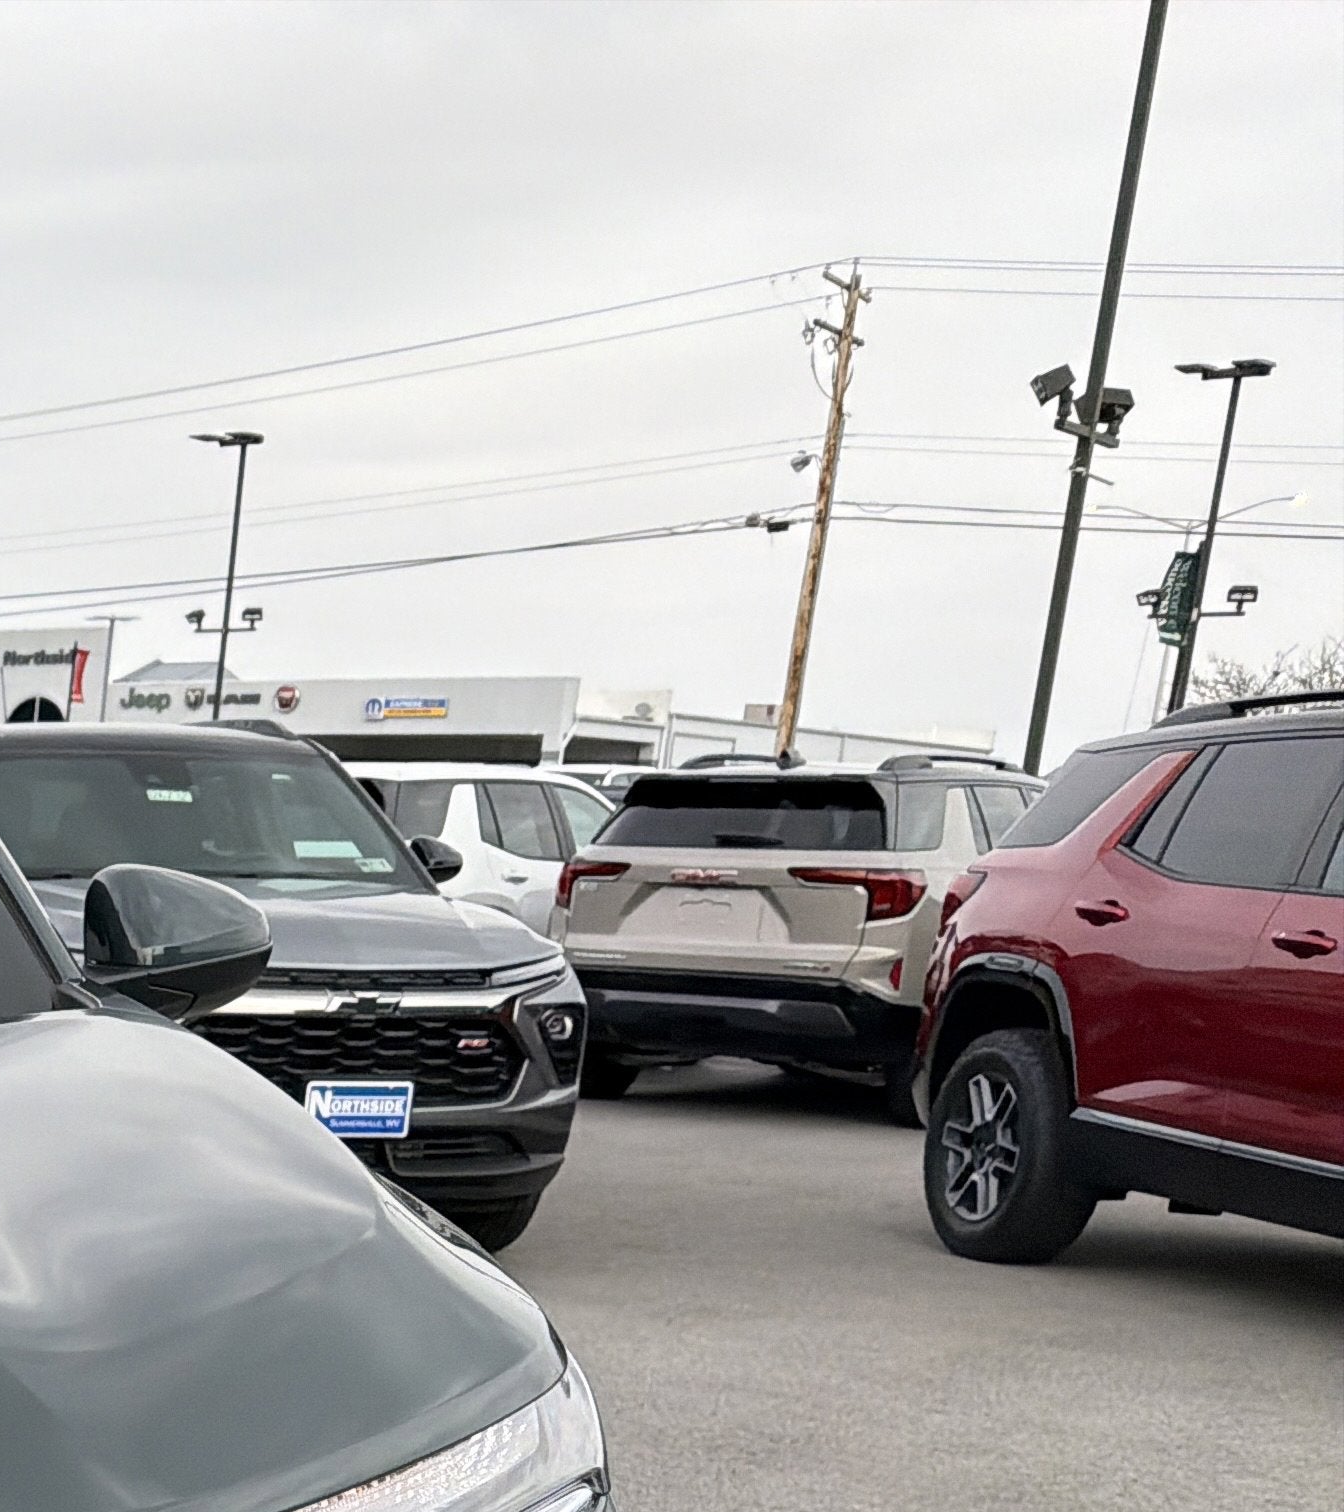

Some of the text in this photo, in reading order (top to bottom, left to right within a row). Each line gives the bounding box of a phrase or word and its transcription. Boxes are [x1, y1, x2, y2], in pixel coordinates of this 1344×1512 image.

[3, 648, 76, 666] Northsid
[120, 687, 171, 714] Jeep
[311, 1089, 405, 1118] NORTHSIDE
